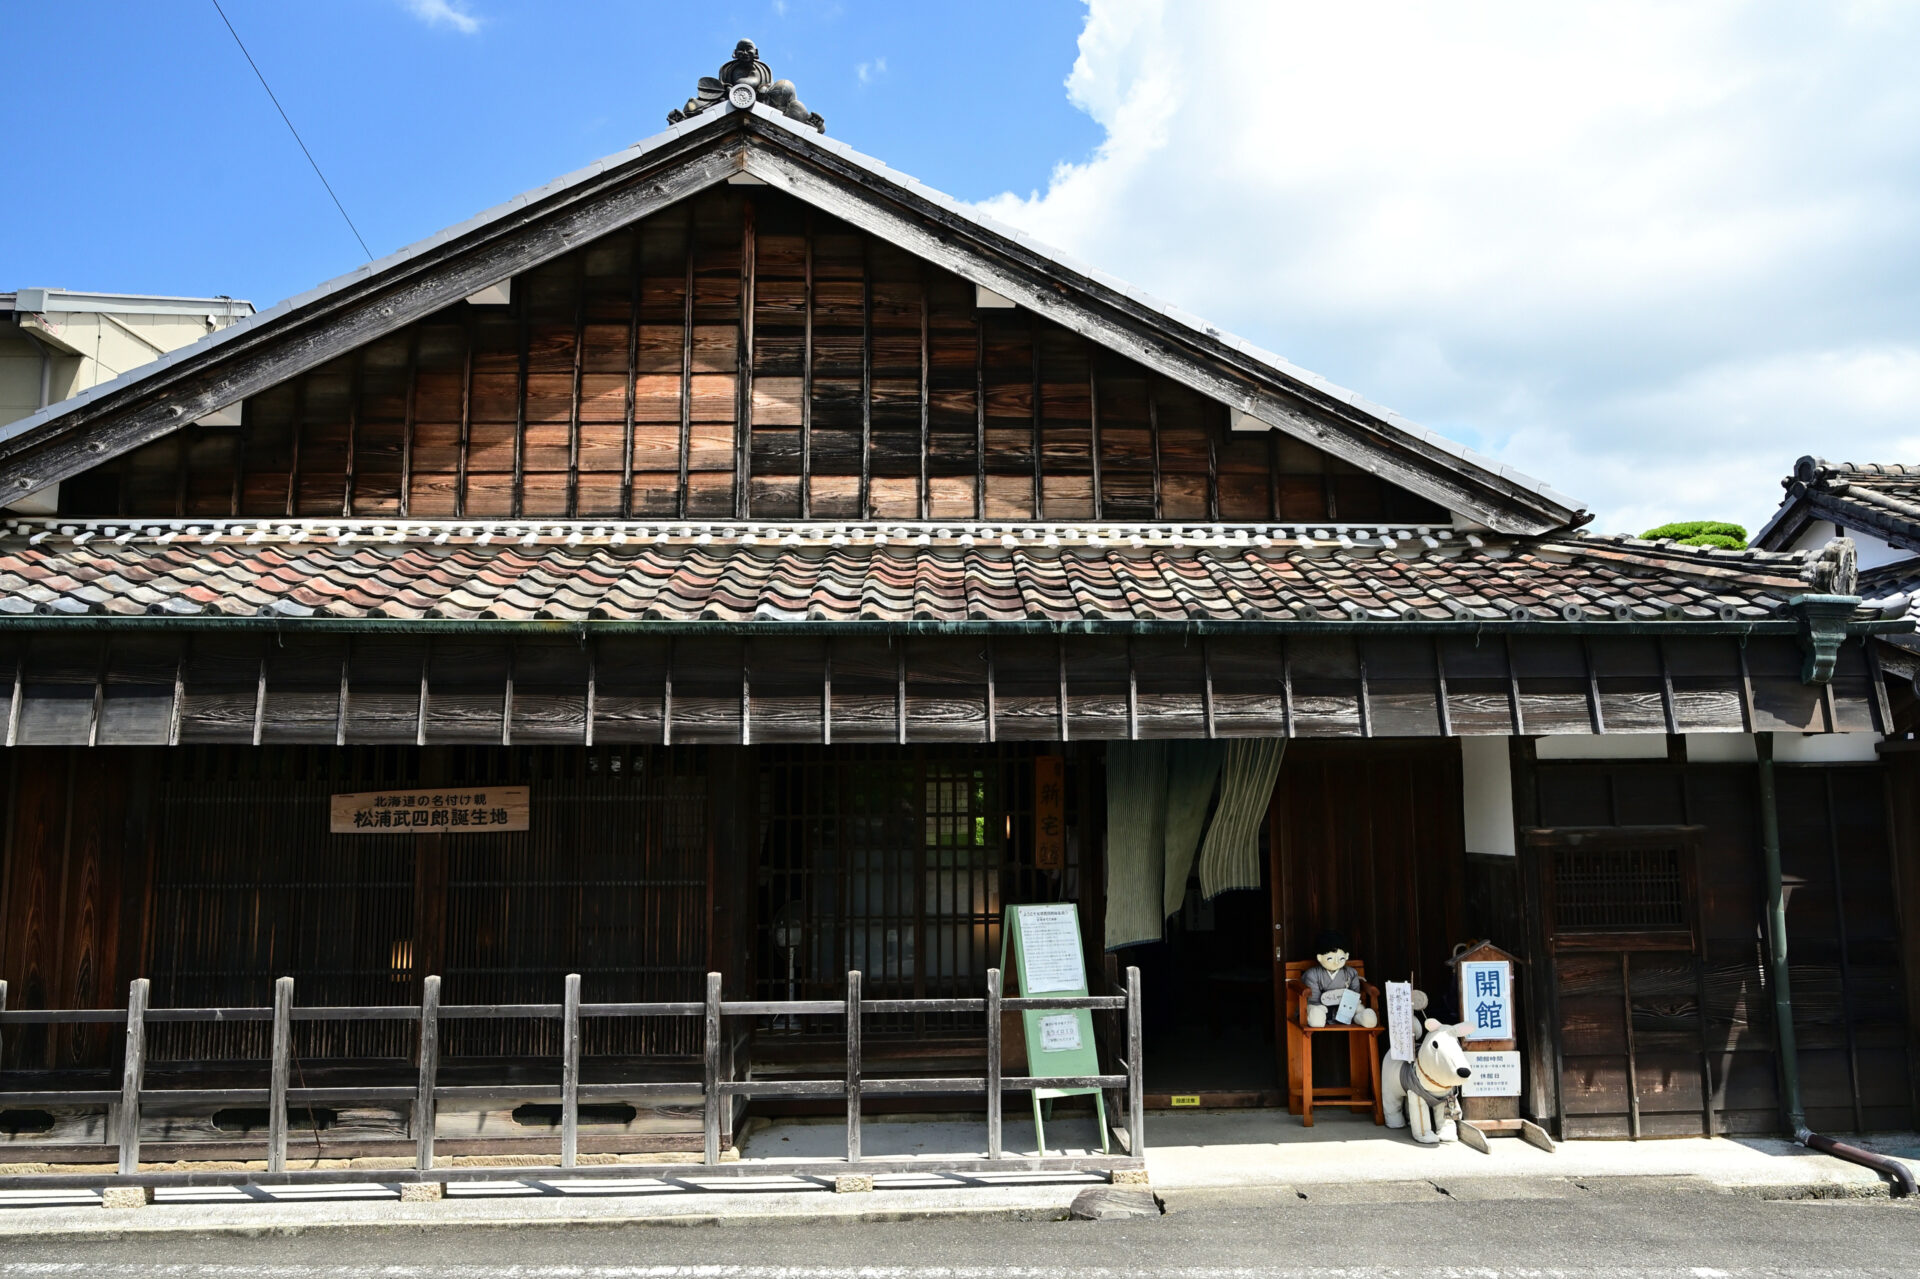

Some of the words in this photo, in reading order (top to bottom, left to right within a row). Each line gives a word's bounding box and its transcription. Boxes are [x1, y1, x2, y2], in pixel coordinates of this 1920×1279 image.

[374, 794, 487, 808] 北海道の名付け親
[353, 808, 508, 828] 松浦武四郎誕生地
[1475, 970, 1503, 1029] 開館
